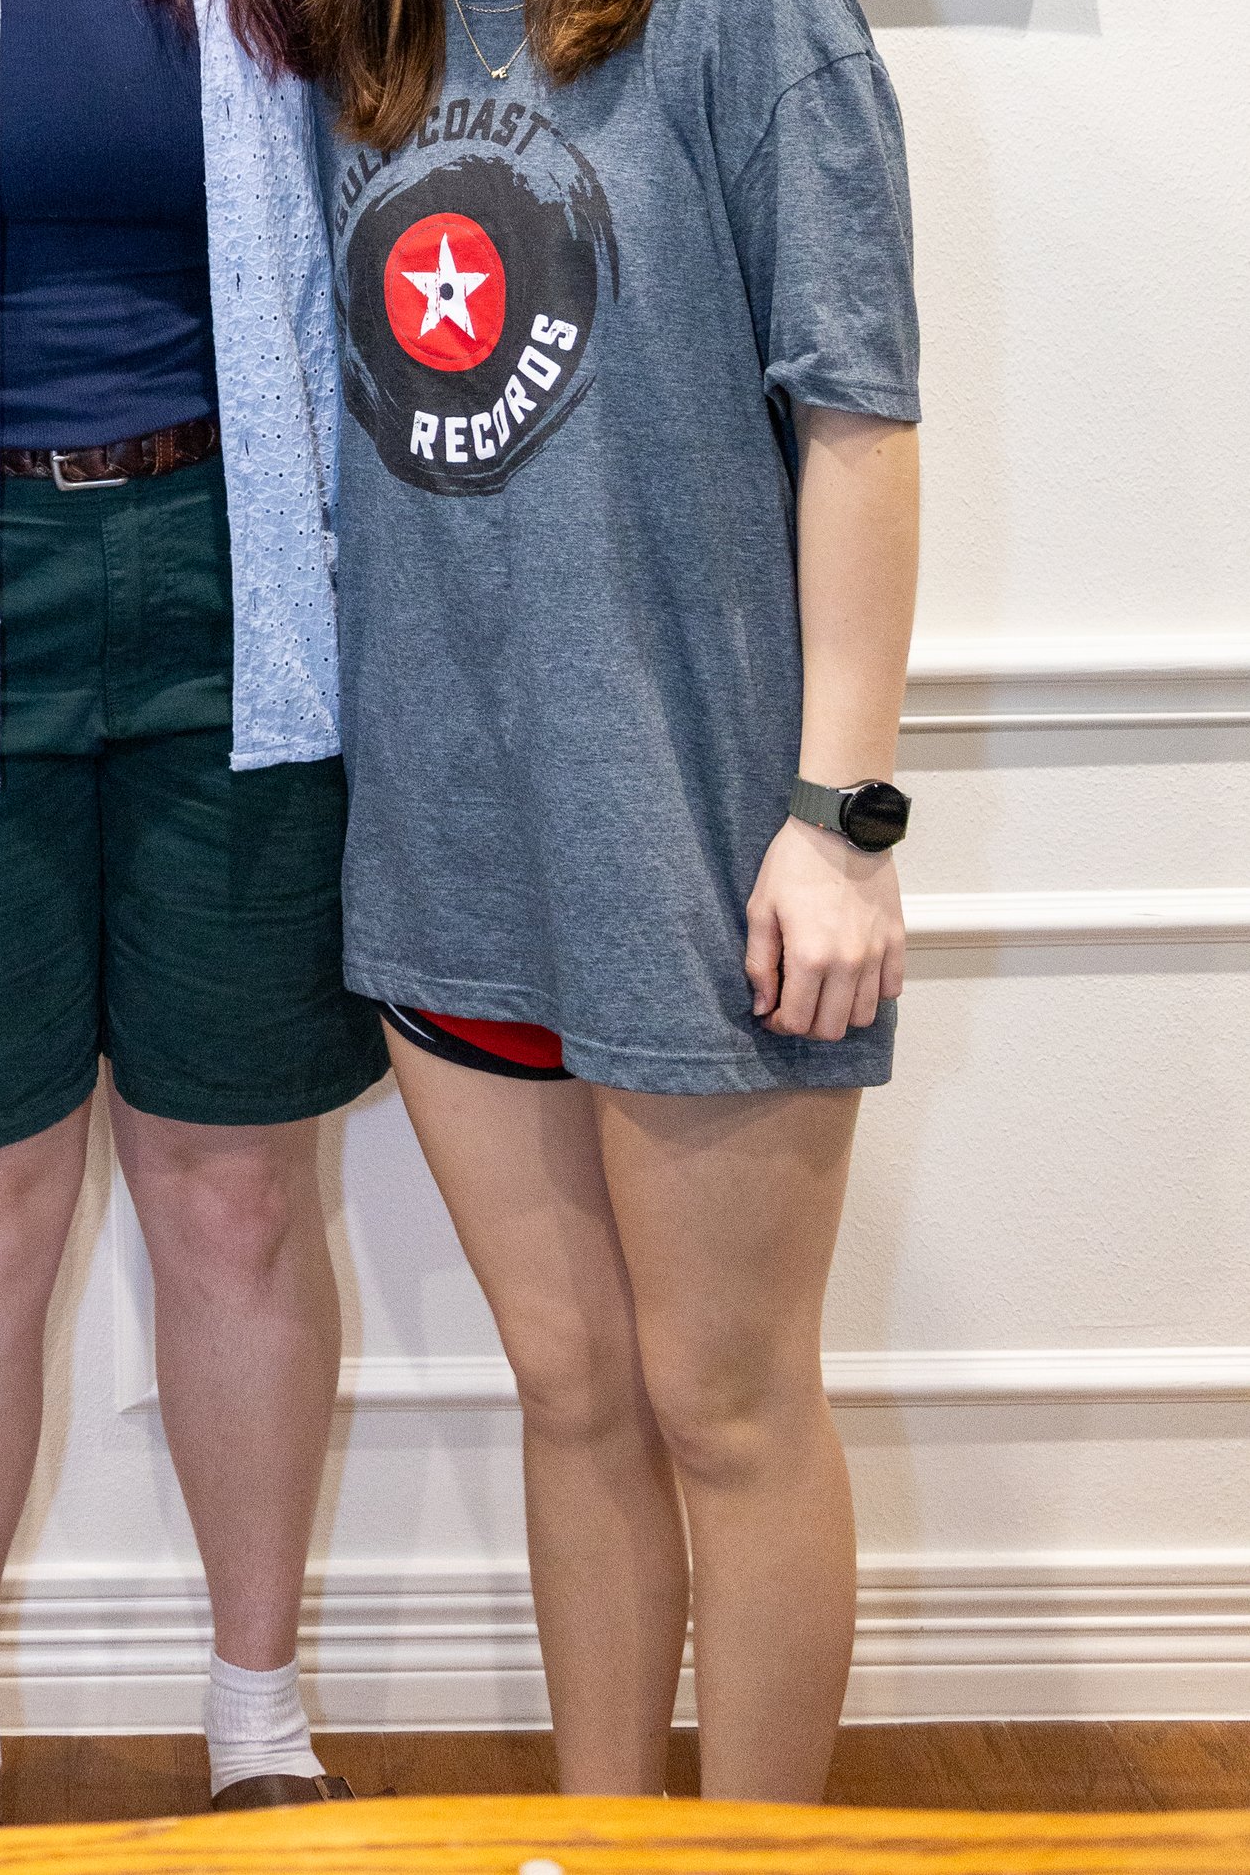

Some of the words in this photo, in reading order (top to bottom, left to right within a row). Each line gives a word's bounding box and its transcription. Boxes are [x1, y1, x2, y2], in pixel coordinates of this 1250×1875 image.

[334, 149, 392, 238] GUL
[417, 97, 552, 156] COAST
[409, 313, 579, 463] RECORDS
